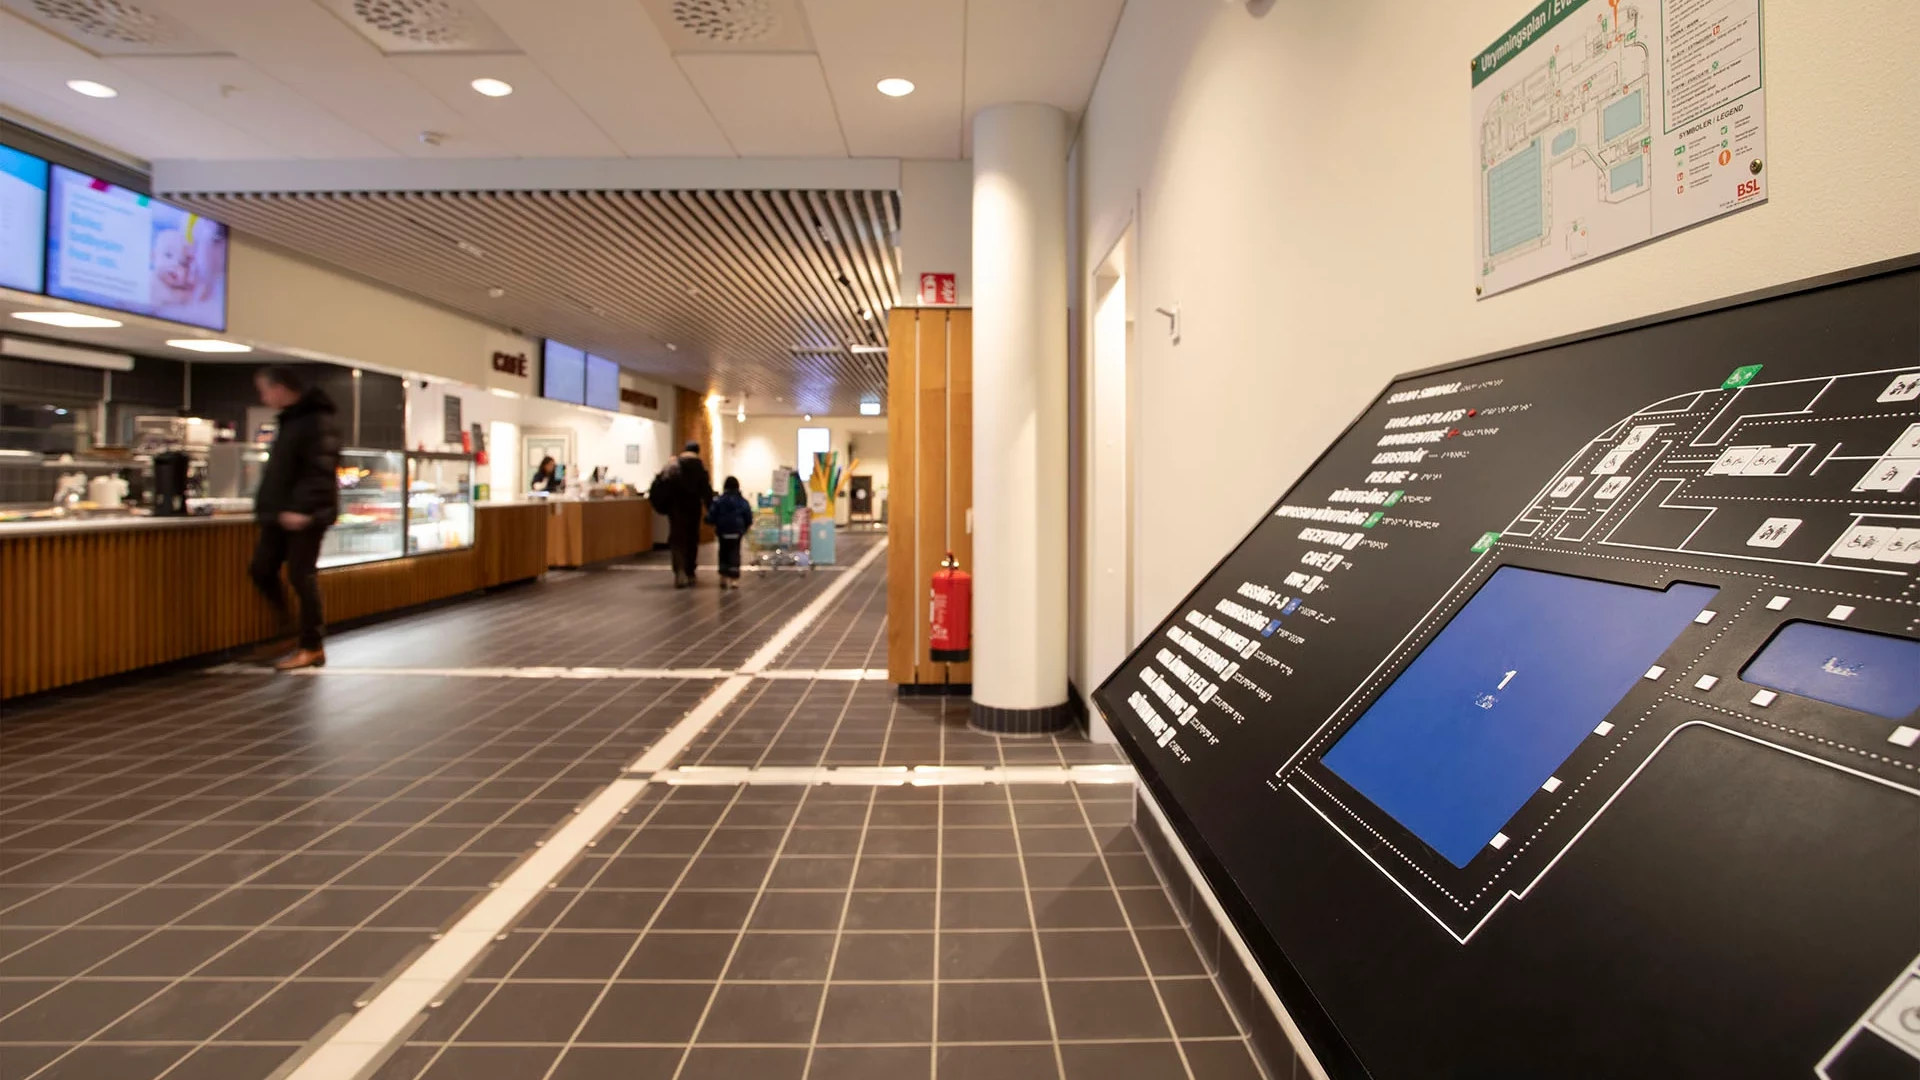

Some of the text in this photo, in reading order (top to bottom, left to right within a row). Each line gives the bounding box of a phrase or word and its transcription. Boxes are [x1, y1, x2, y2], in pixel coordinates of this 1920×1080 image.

[1480, 11, 1546, 72] Utrymningsplan
[1679, 119, 1712, 139] SYMBOLER
[1716, 104, 1744, 122] LEGEND
[1737, 179, 1760, 197] BSL
[1298, 527, 1350, 547] RECEPTION
[1300, 551, 1333, 568] CAFÉ
[1237, 581, 1276, 605] BASSÄNG
[1188, 671, 1210, 696] FLEX
[1497, 670, 1518, 690] 1
